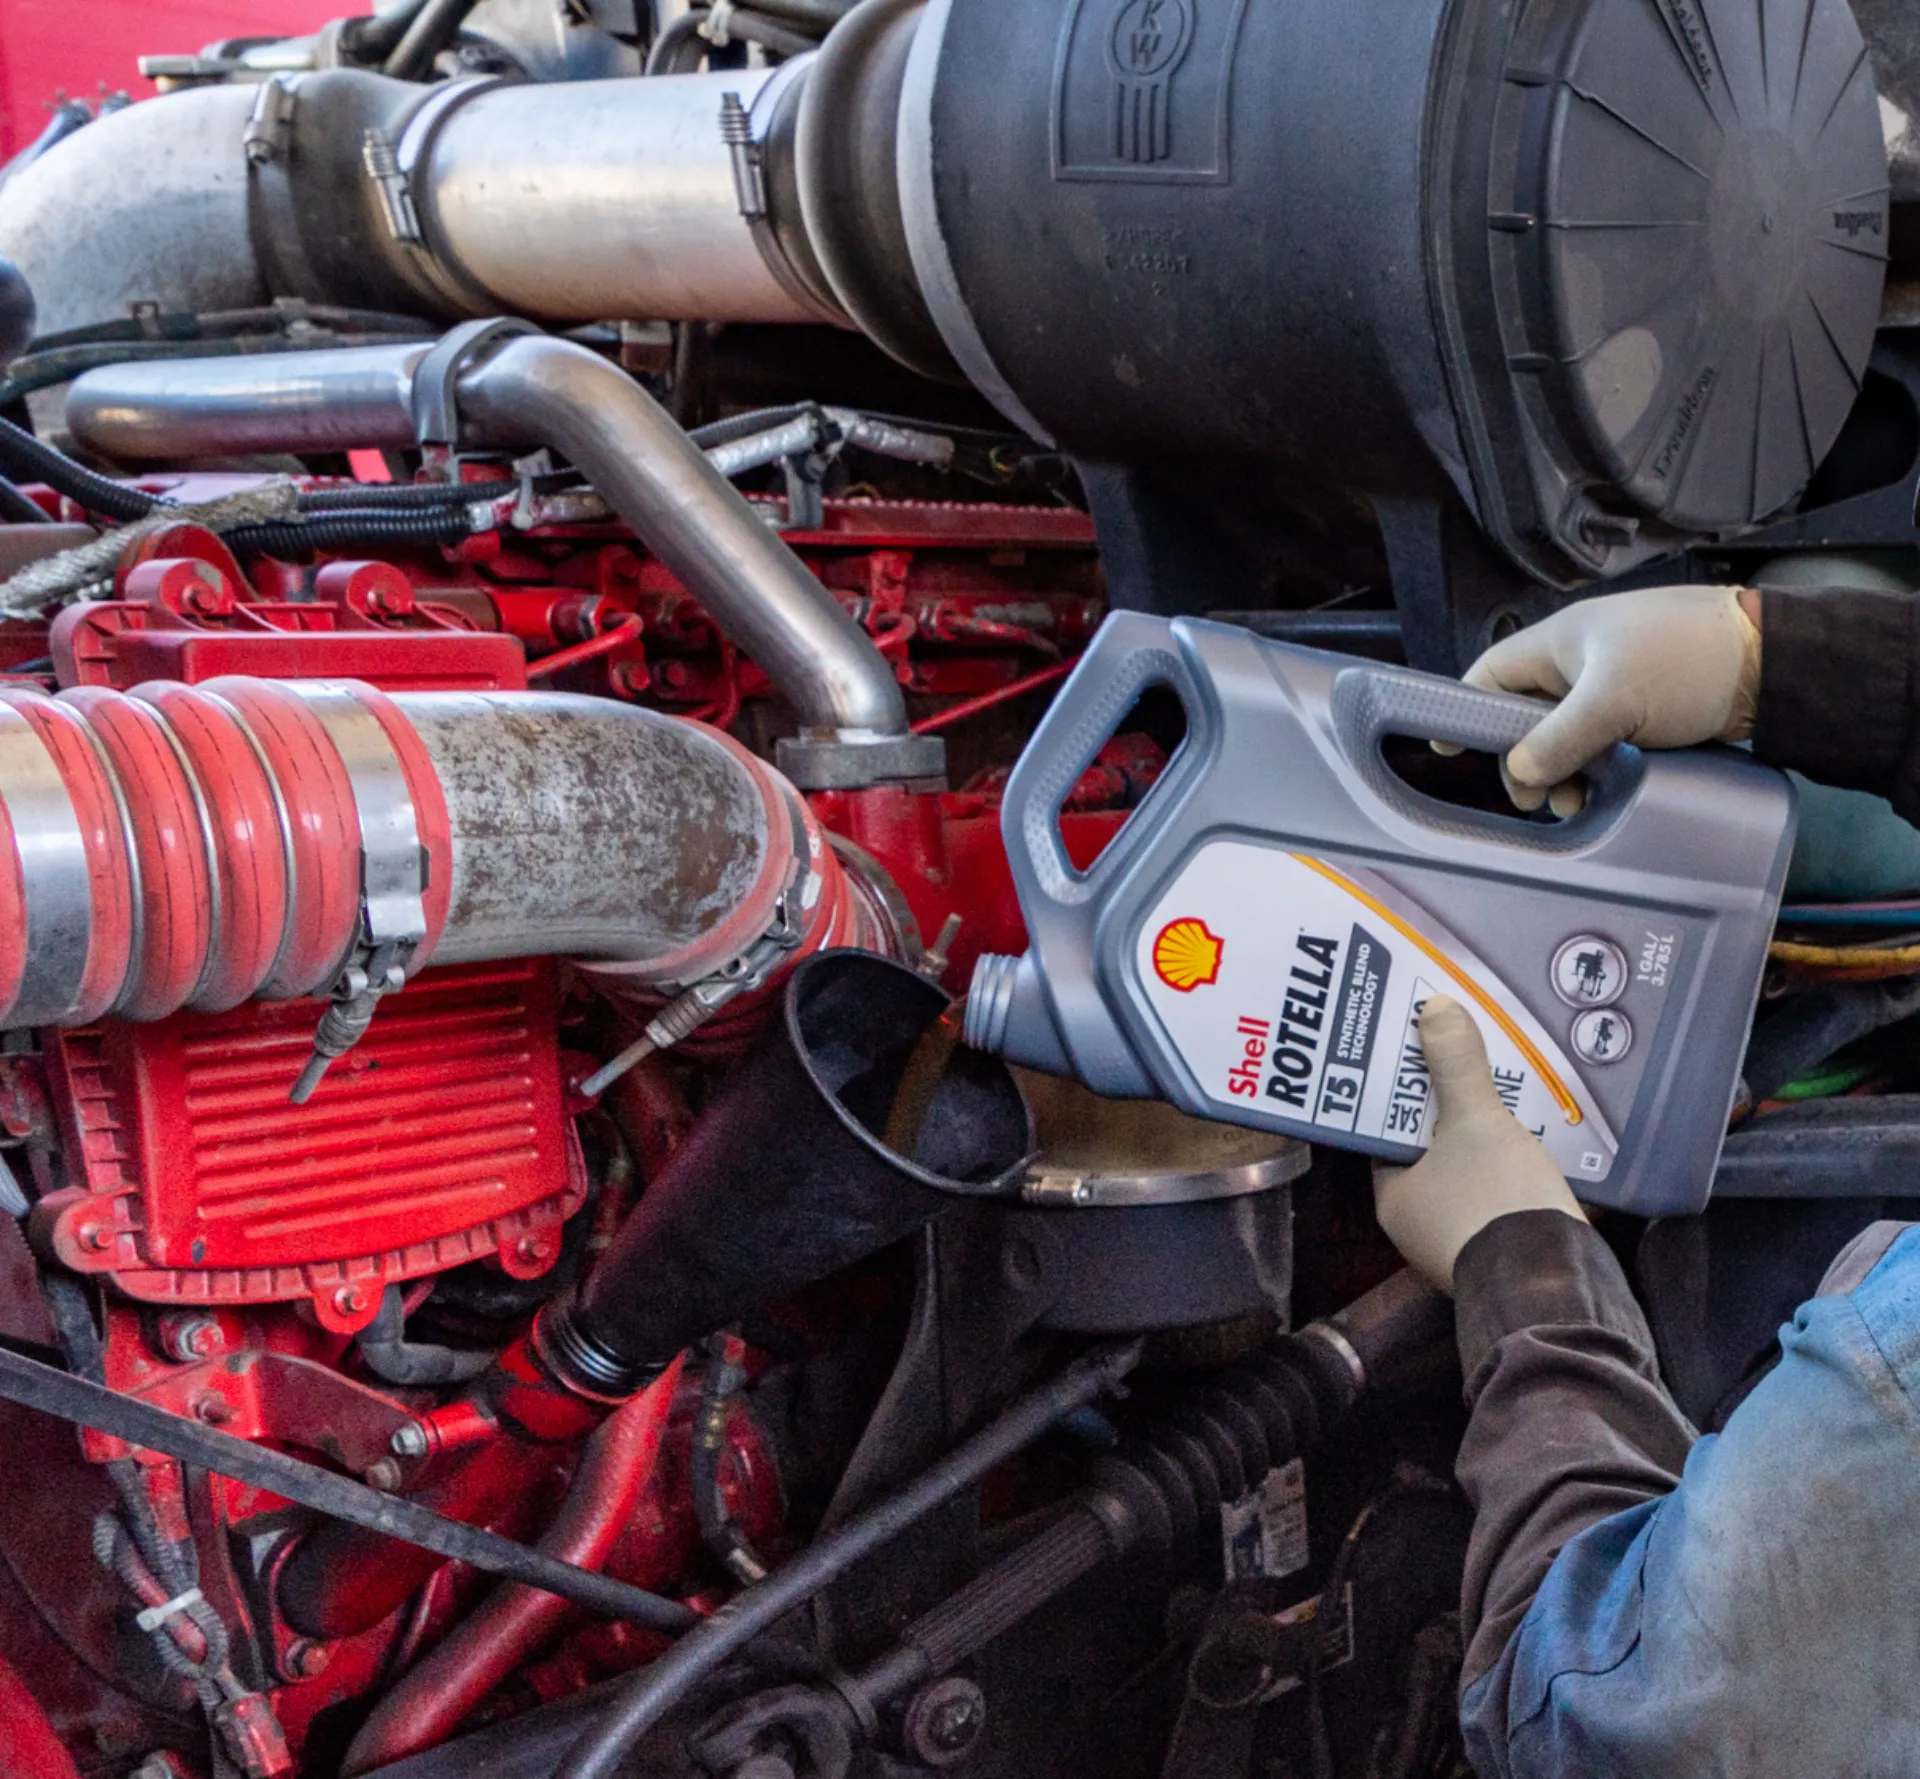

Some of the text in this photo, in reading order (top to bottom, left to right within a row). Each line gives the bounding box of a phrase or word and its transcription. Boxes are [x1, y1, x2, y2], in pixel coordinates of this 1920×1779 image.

[1265, 933, 1340, 1109] ROTELLA
[1336, 943, 1371, 1059] SYNTHETIC BLEND
[1349, 970, 1379, 1061] TECHNOLOGY
[1228, 1016, 1271, 1099] Shell
[1321, 1075, 1359, 1115] T5
[1387, 1103, 1423, 1134] SAE
